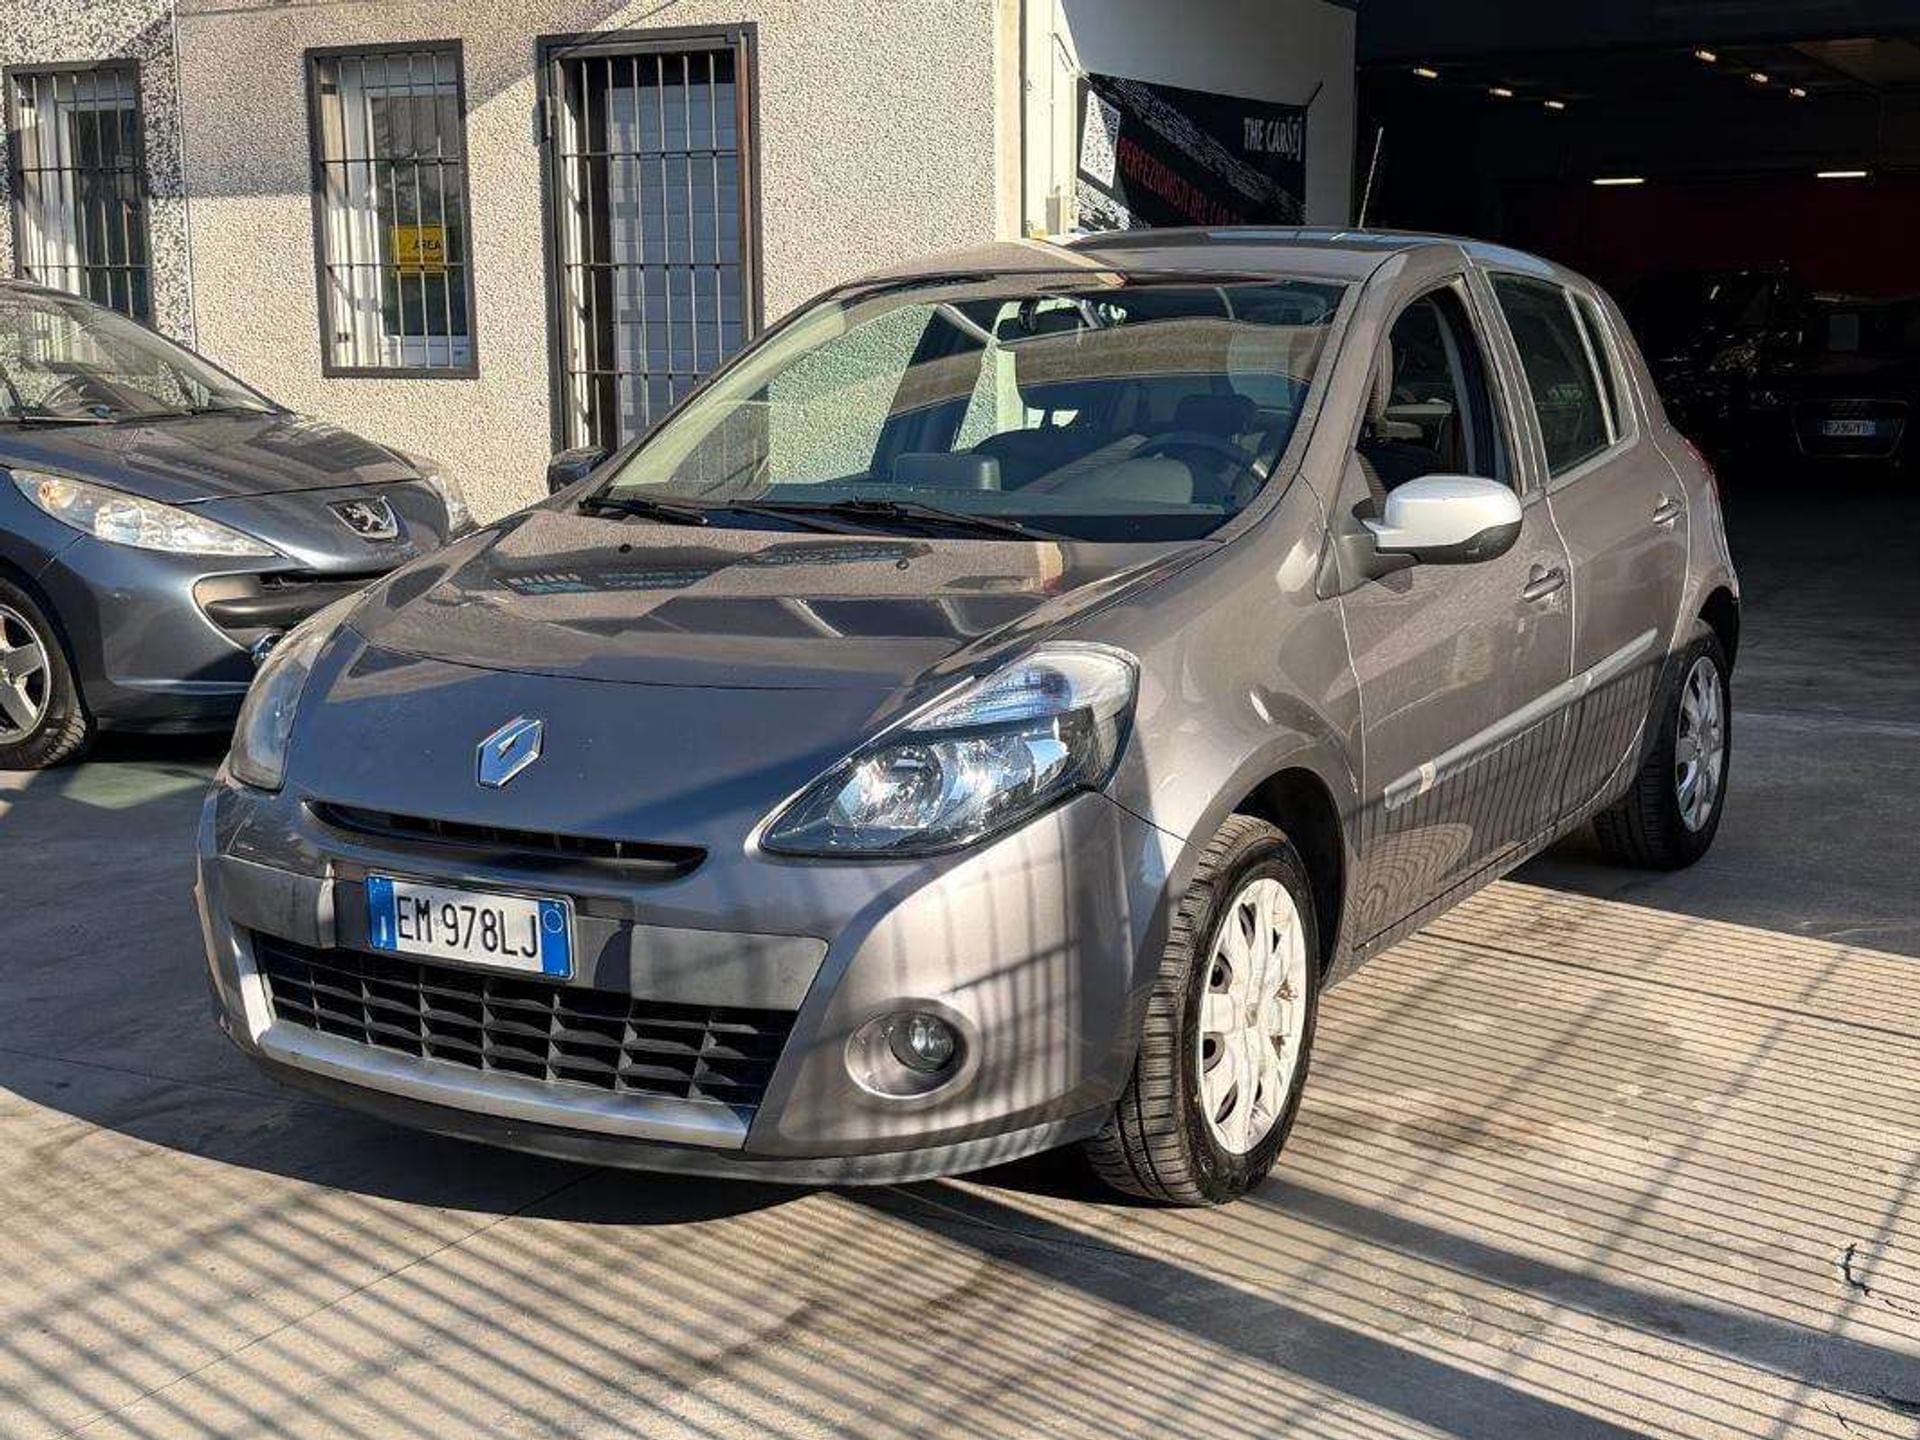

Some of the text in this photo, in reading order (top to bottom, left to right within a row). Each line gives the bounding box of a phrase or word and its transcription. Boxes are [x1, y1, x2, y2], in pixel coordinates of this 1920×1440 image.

[1244, 116, 1265, 152] THE
[397, 897, 539, 958] EM 978LJ
